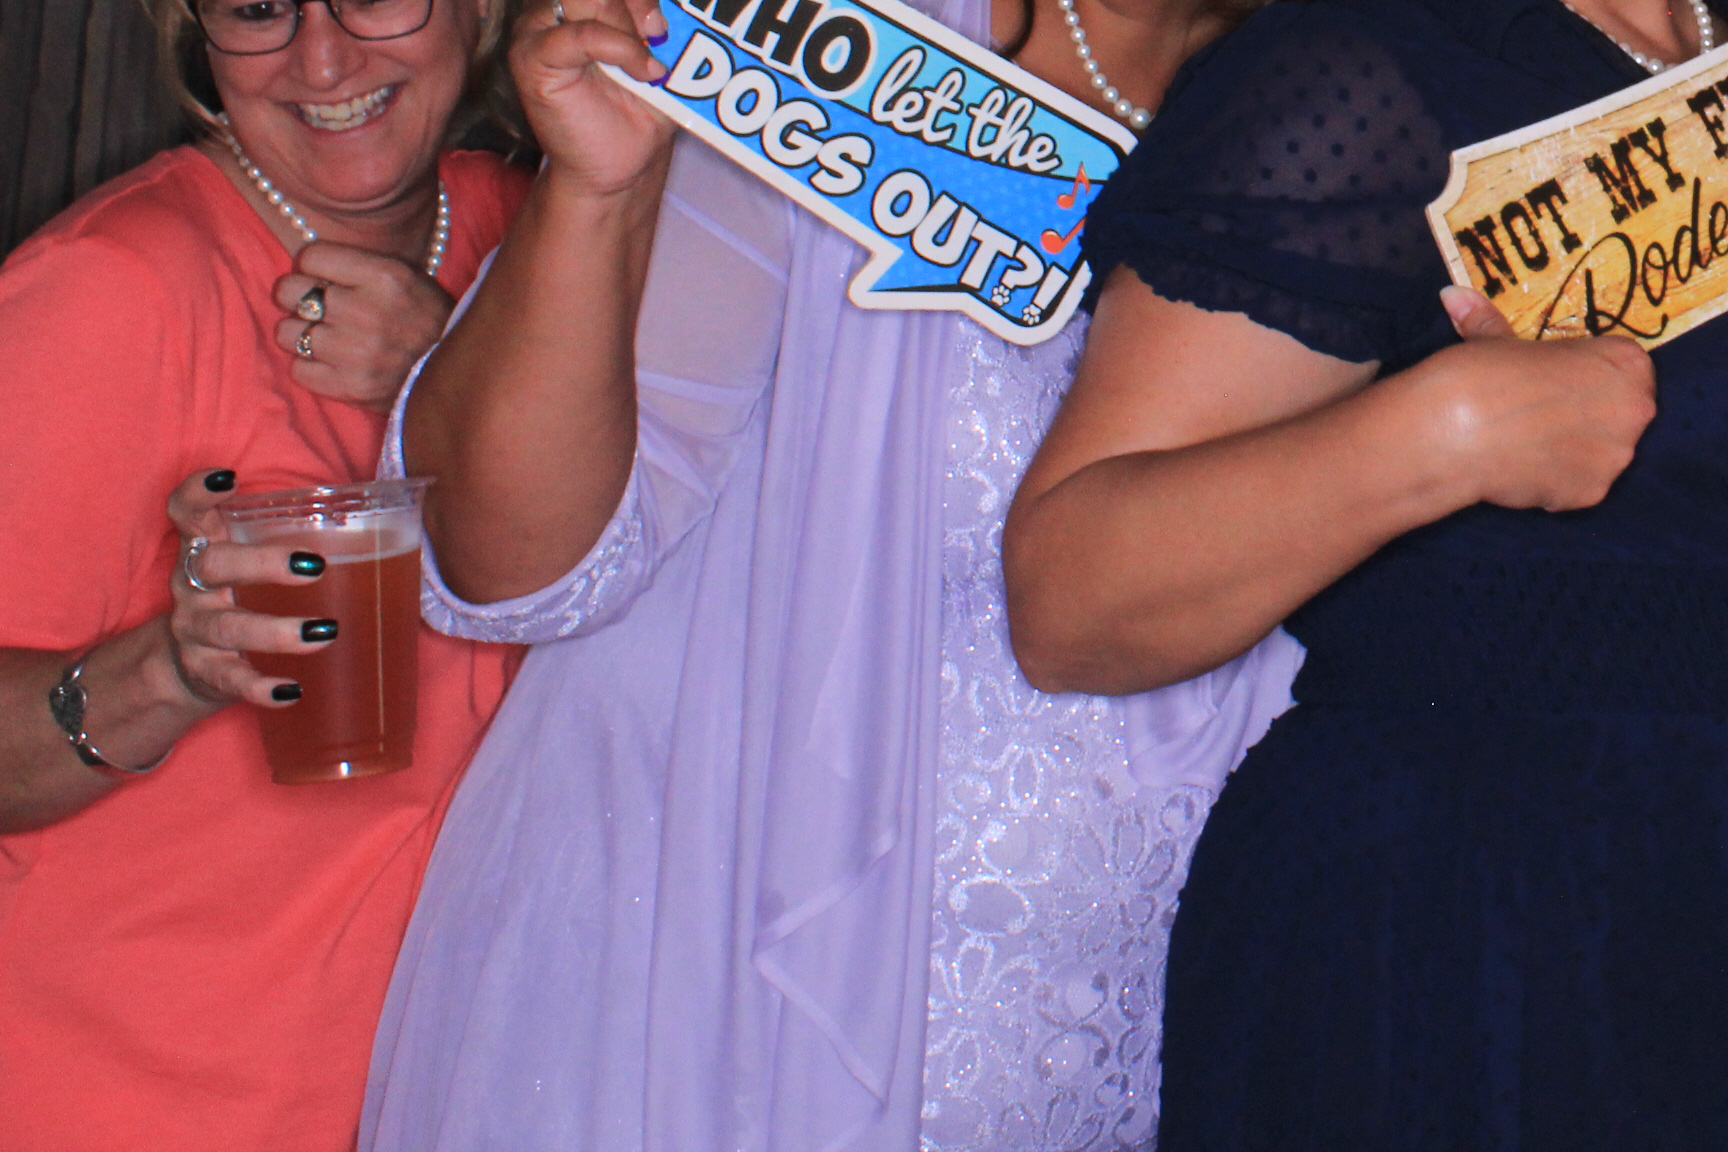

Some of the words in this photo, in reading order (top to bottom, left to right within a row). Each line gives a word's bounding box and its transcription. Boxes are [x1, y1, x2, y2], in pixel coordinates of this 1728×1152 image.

[663, 31, 875, 196] DOGS
[872, 169, 1070, 326] OUT?!
[873, 46, 963, 145] let
[967, 84, 1063, 173] the
[1455, 178, 1583, 299] NOT
[1584, 117, 1686, 225] MY
